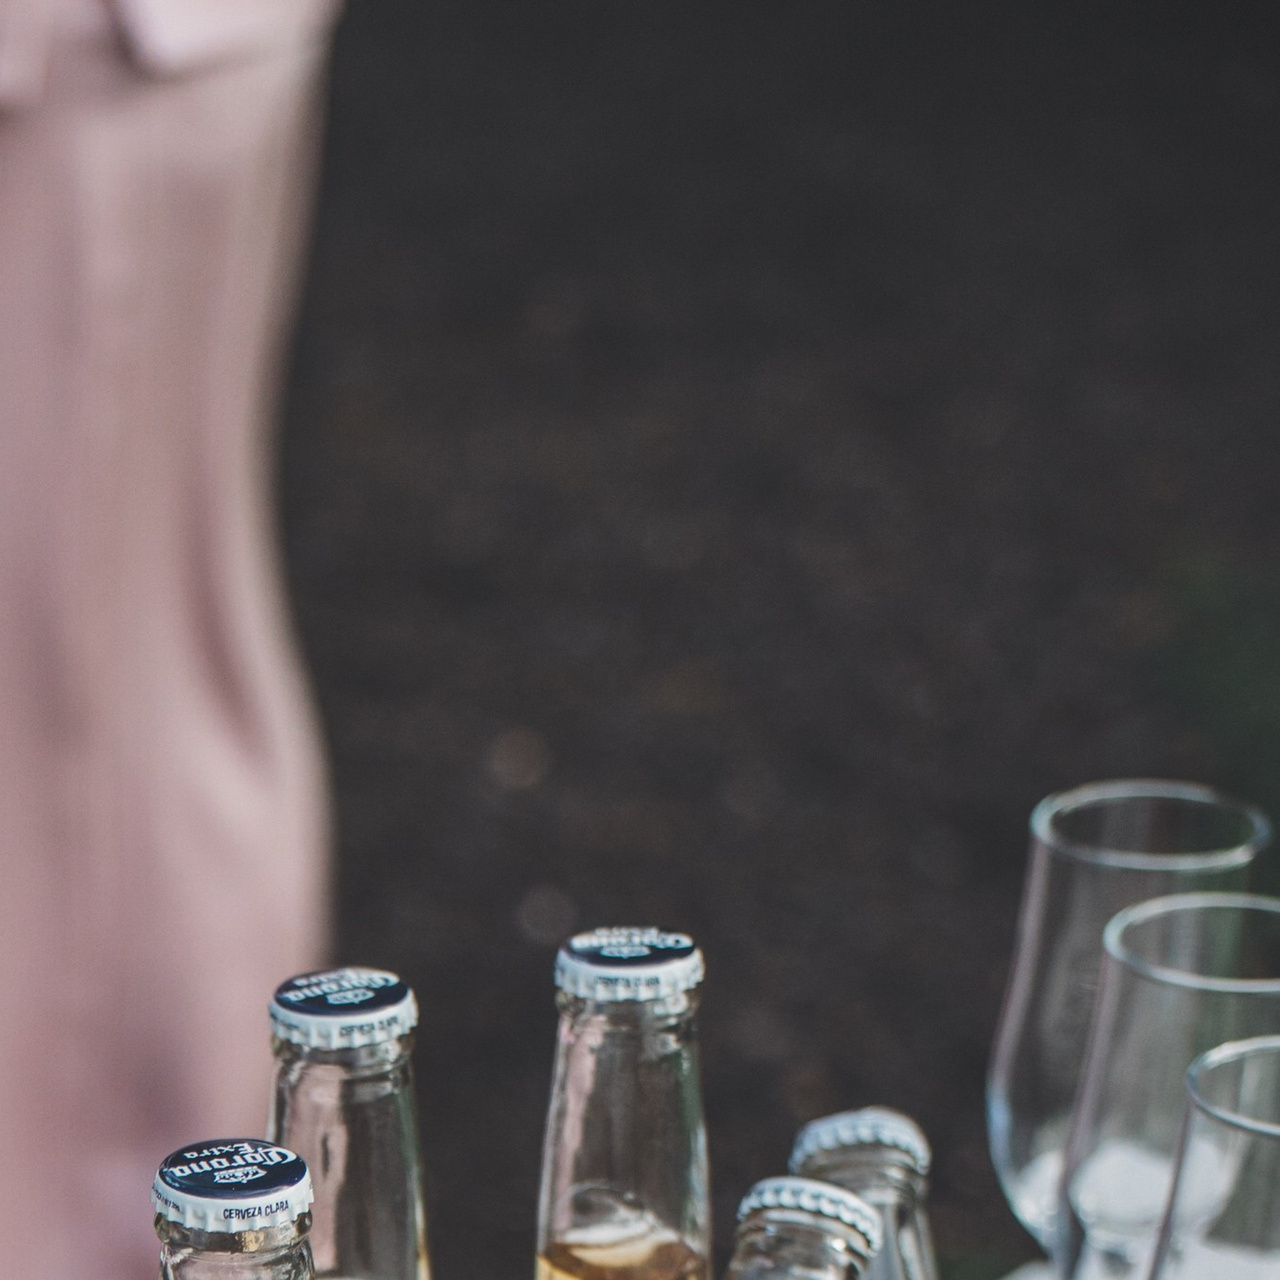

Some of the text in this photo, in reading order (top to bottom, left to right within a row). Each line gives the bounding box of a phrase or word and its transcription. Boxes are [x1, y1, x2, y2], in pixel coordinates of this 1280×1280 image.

[183, 1142, 255, 1159] Extra
[167, 1146, 298, 1178] Corona
[223, 1199, 290, 1220] CERVEZA CLARA
